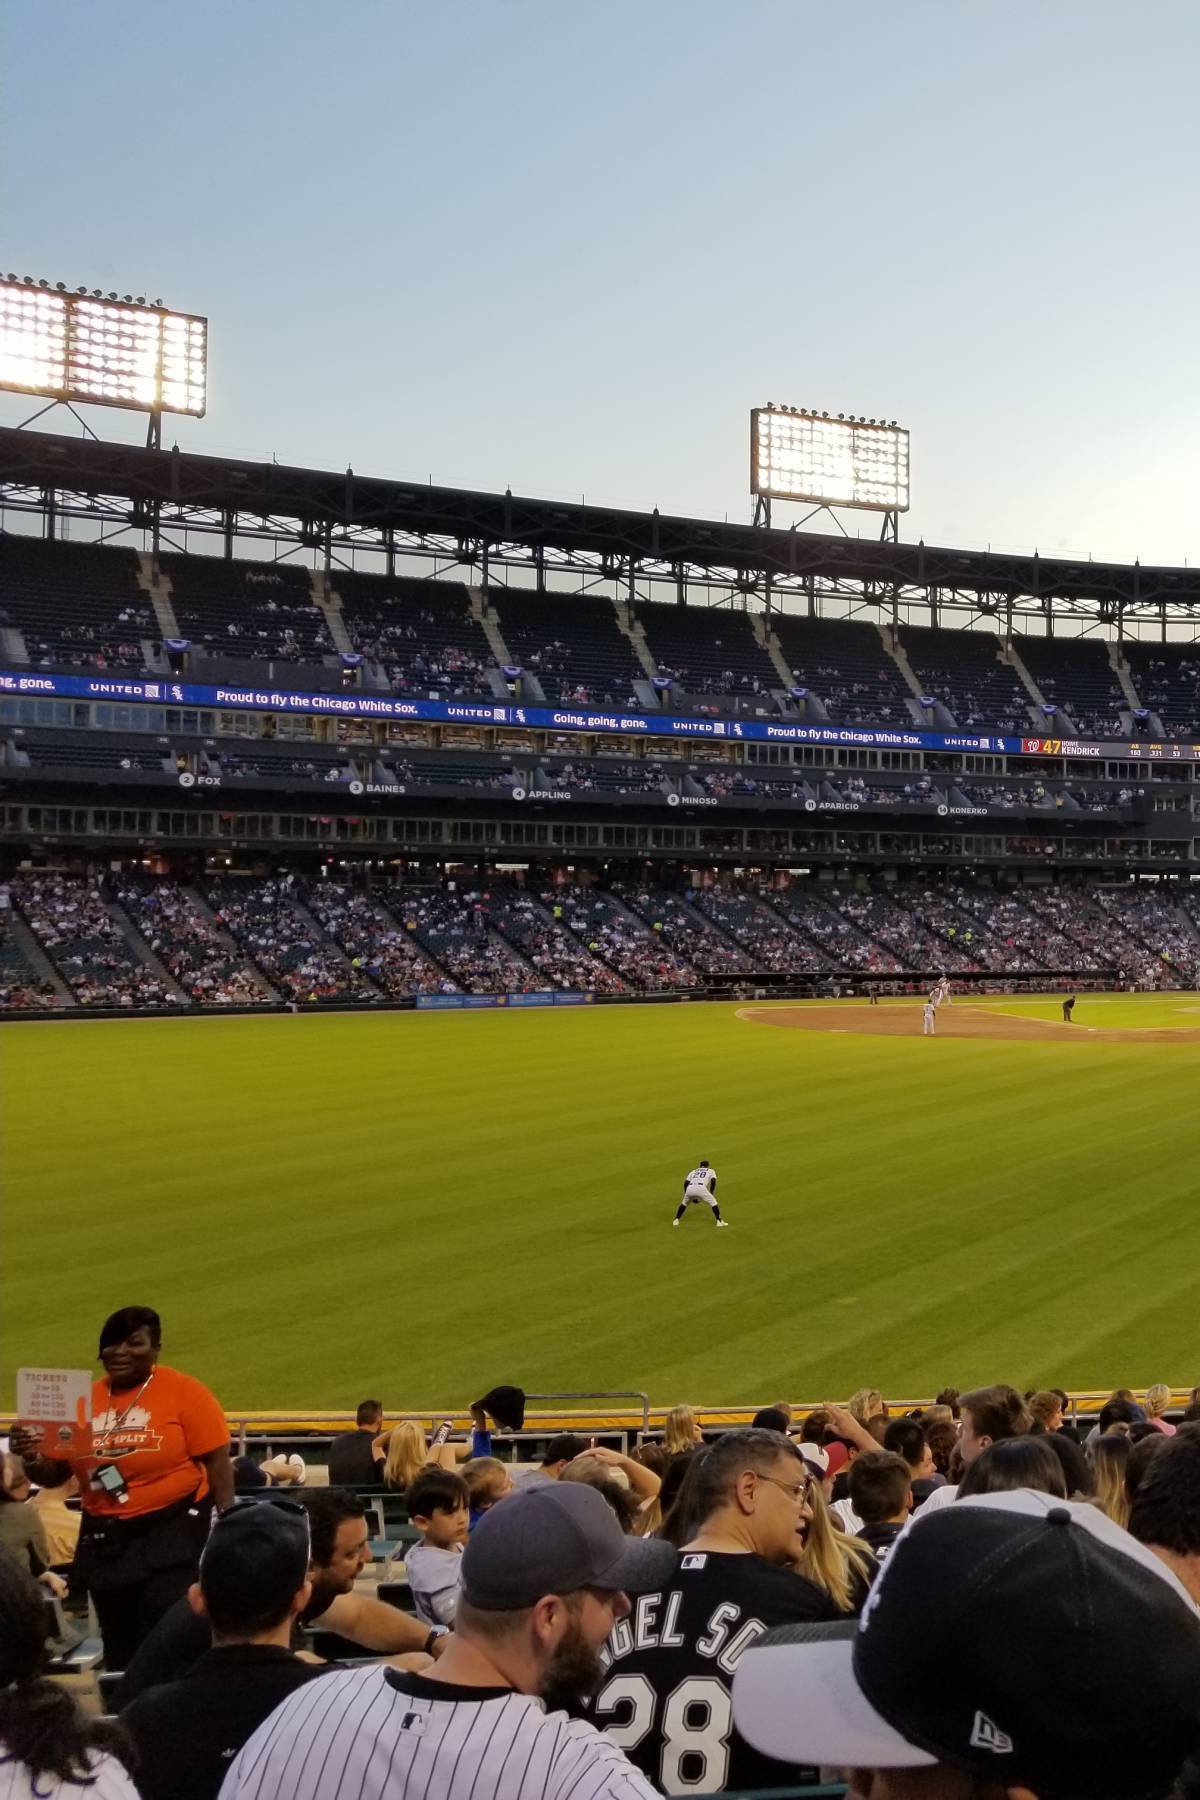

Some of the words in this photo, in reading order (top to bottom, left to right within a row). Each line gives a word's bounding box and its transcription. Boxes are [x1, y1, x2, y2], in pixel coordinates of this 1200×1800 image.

[19, 678, 55, 689] gone.
[90, 683, 143, 694] UNITED
[217, 690, 253, 703] Proud
[256, 693, 268, 703] to
[270, 693, 287, 706] fly
[289, 695, 310, 706] the
[311, 697, 356, 711] Chicago
[358, 700, 392, 712] White
[394, 703, 419, 714] Sox.
[448, 707, 492, 717] UNITED
[553, 713, 586, 726] Going,
[587, 716, 619, 728] going,
[620, 719, 648, 729] gone.
[673, 722, 713, 731] UNITED
[767, 727, 796, 737] Proud
[797, 728, 807, 738] to
[809, 729, 820, 739] fly
[823, 730, 838, 739] the
[840, 731, 874, 743] Chicago
[875, 734, 902, 743] White
[903, 735, 922, 745] Sox.
[944, 738, 979, 747] UNITED
[1043, 739, 1062, 755] 47
[1061, 747, 1100, 757] KENDRICK
[197, 776, 221, 786] FOX
[366, 784, 406, 794] BAINES
[527, 790, 572, 800] APPLING
[681, 796, 719, 805] MINOSO
[818, 801, 859, 811] APARICIO
[950, 807, 988, 816] KONERKO
[23, 1373, 68, 1383] TICKETS
[598, 1591, 685, 1674] GEL
[594, 1673, 733, 1797] 28
